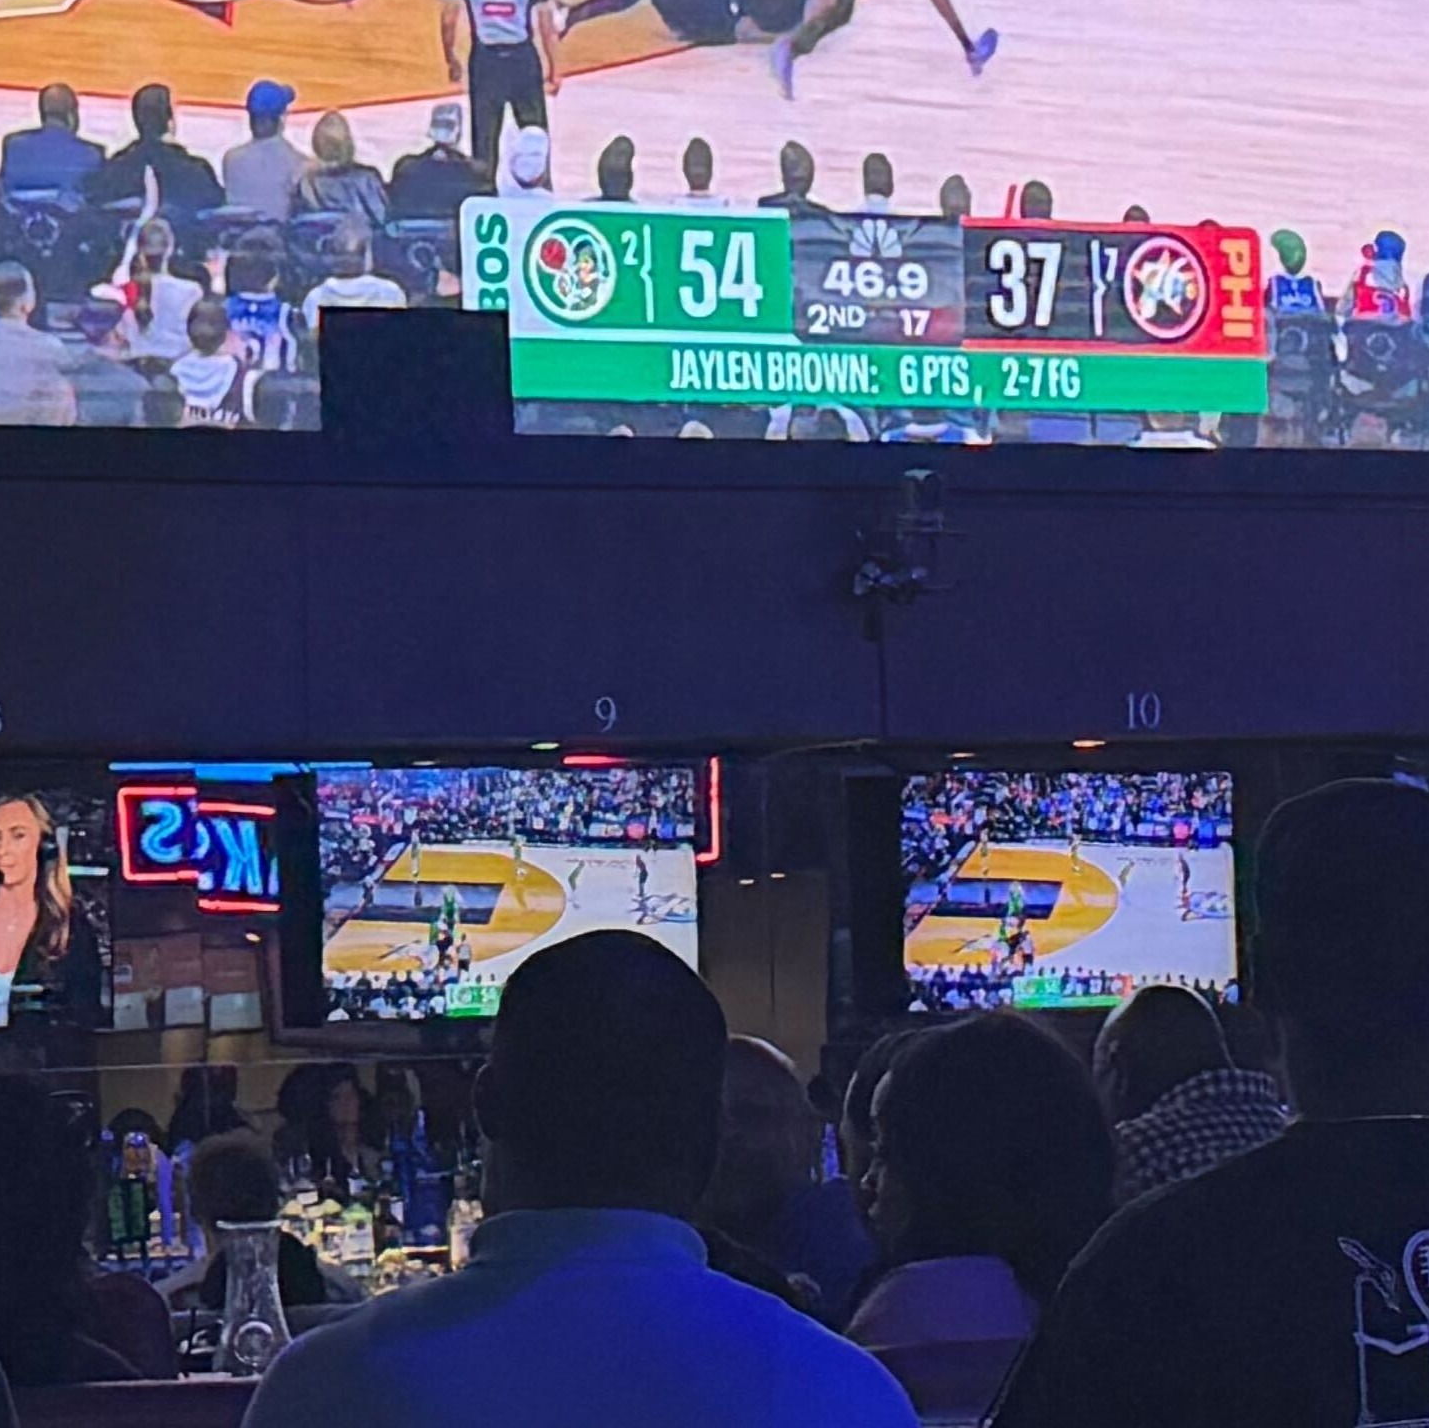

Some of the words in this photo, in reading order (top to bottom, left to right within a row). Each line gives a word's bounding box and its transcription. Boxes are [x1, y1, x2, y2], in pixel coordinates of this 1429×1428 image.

[621, 230, 638, 266] 2
[678, 228, 764, 319] 54
[823, 258, 929, 300] 46.9
[989, 238, 1064, 329] 37
[1219, 238, 1256, 340] PHI
[807, 304, 867, 336] 2ND
[899, 309, 931, 337] 17
[669, 349, 763, 392] JAYLEN
[1001, 359, 1045, 398] 2-7
[1047, 360, 1082, 399] FG
[594, 695, 617, 733] 9
[1126, 691, 1162, 729] 10
